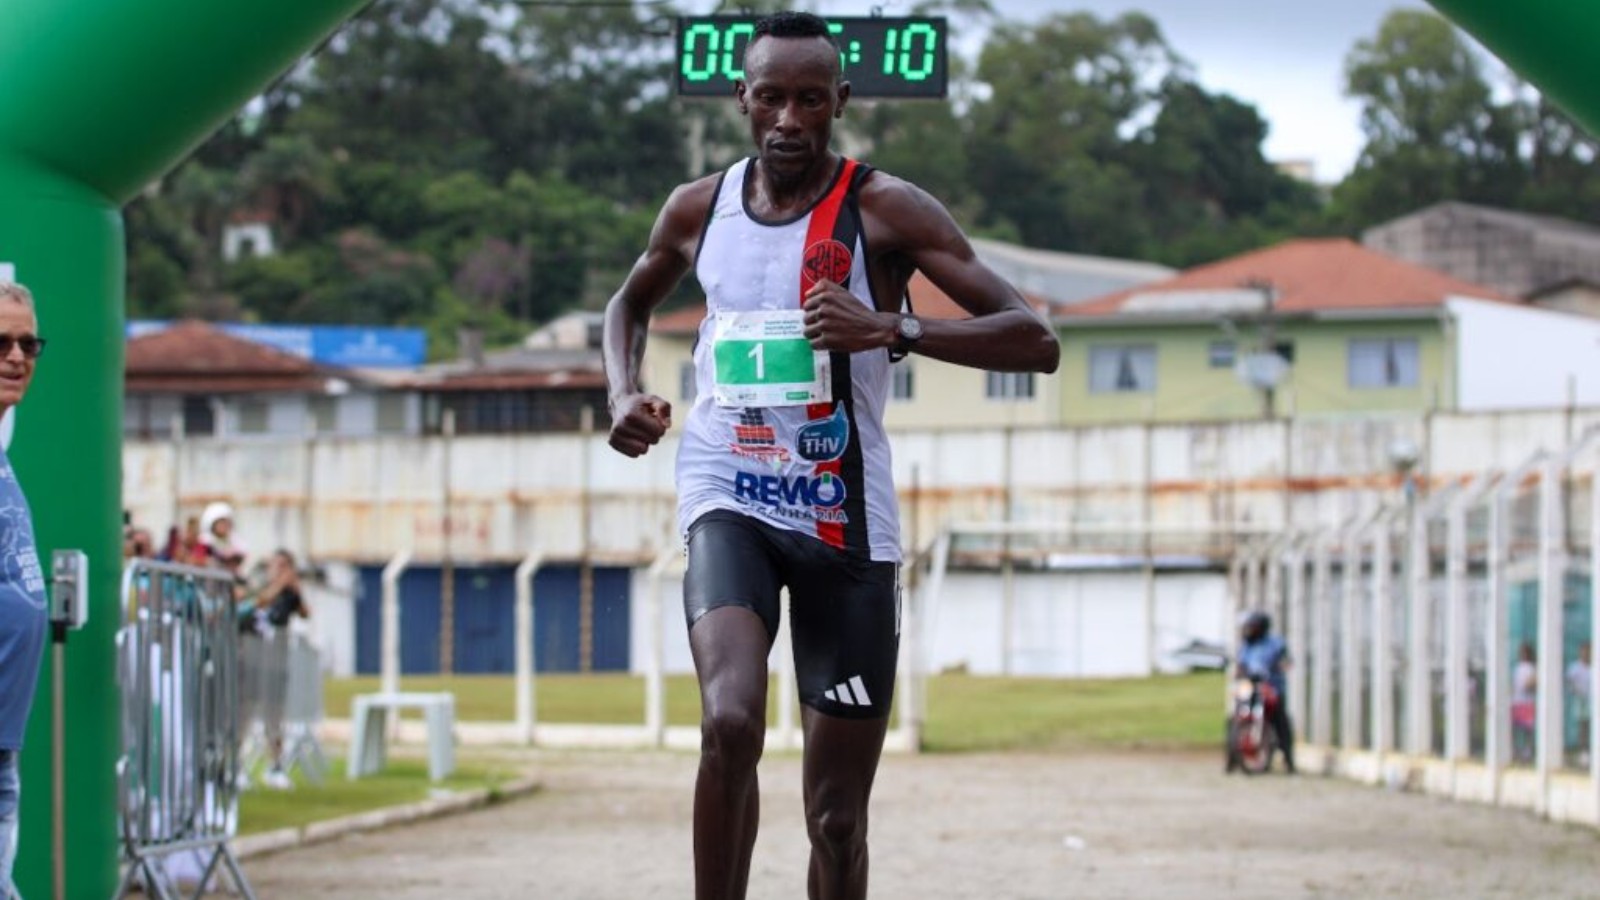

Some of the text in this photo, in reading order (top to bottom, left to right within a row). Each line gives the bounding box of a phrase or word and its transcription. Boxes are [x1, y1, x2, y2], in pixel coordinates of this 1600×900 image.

[748, 343, 764, 379] 1
[803, 437, 840, 454] THV
[735, 471, 846, 508] REMO
